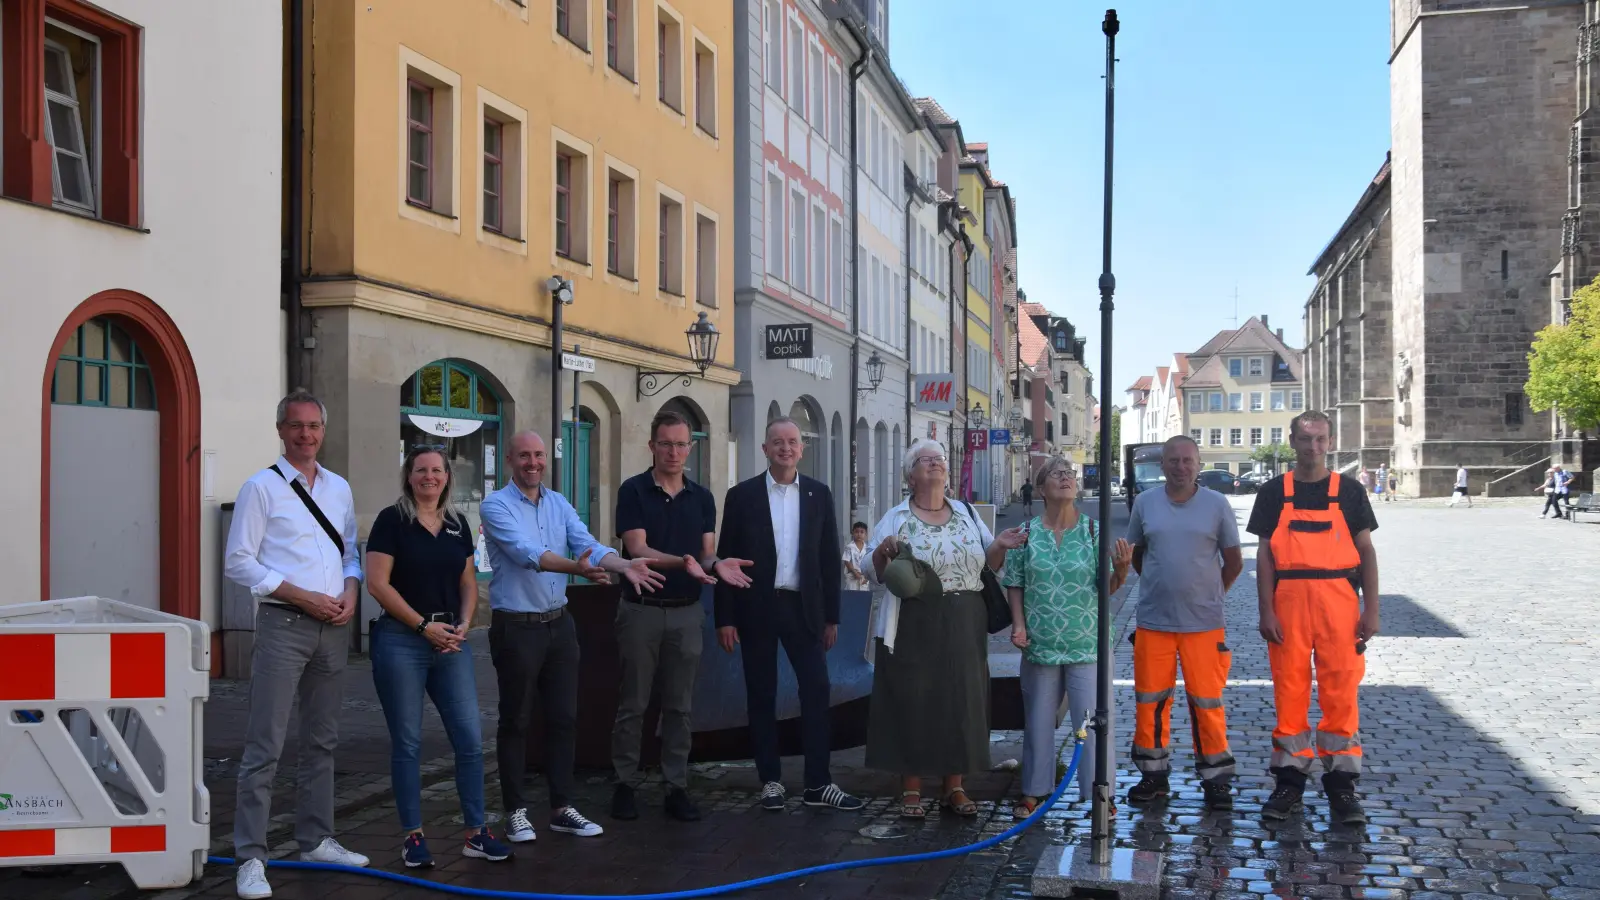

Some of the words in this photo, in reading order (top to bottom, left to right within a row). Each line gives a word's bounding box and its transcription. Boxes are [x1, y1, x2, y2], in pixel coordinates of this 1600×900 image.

[769, 328, 808, 342] MATT
[773, 344, 802, 356] optik
[919, 381, 952, 403] H&M
[435, 421, 445, 431] vhs
[971, 432, 983, 447] T
[5, 797, 63, 808] ANSBACH
